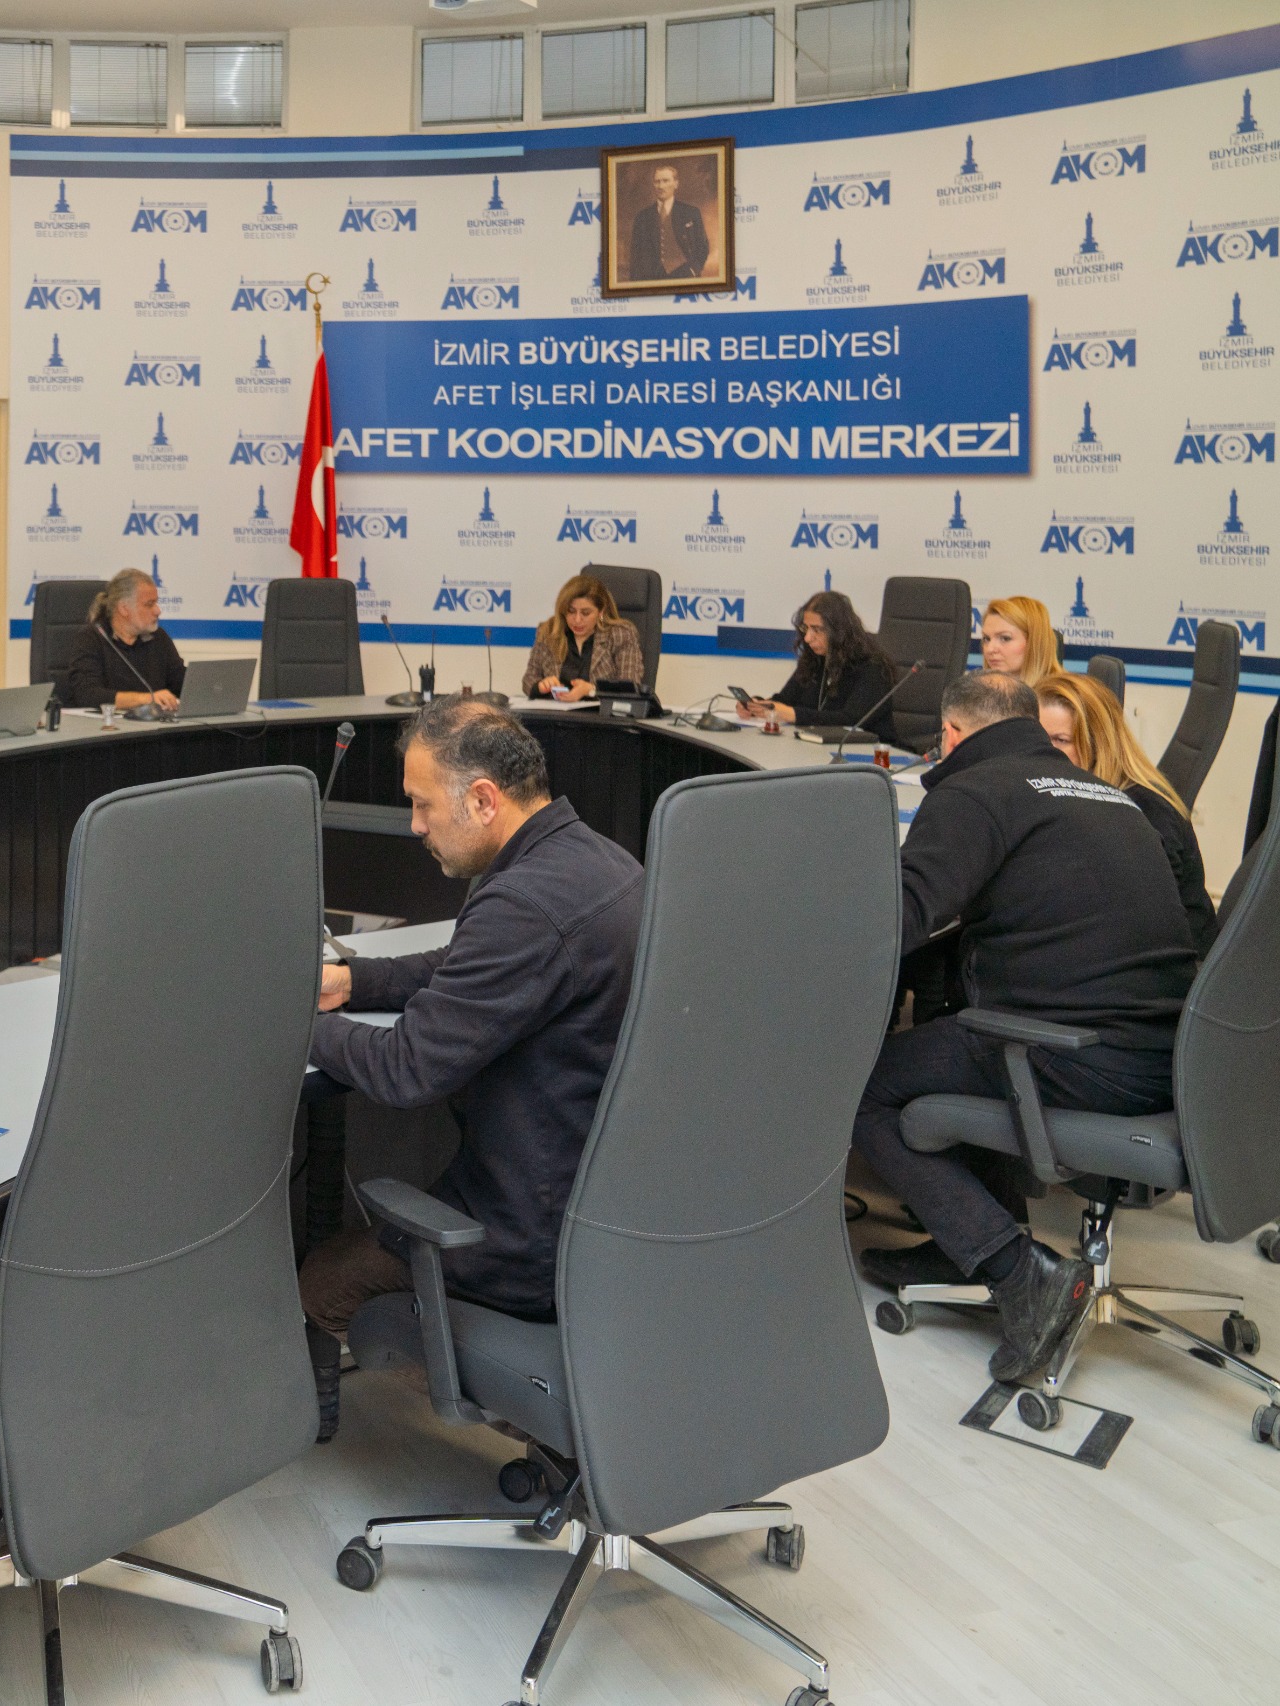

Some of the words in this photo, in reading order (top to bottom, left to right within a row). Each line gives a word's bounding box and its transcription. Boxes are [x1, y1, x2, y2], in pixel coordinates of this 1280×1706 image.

[1051, 144, 1146, 185] AKOM
[804, 180, 890, 212] AKOM
[131, 210, 208, 232] AKOM
[339, 208, 416, 232] AKOM
[568, 201, 601, 226] AK
[1176, 227, 1280, 268] AKOM
[917, 256, 1006, 290] AKOM
[24, 287, 101, 310] AKOM
[231, 288, 307, 311] AKOM
[441, 286, 519, 310] AKOM
[434, 339, 510, 366] İZMİR
[519, 333, 711, 368] BÜYÜKŞEHİR
[720, 326, 900, 361] BELEDİYESİ
[1043, 338, 1136, 372] AKOM
[125, 364, 200, 386] AKOM
[433, 385, 502, 405] AFET
[511, 380, 596, 410] İŞLERİ
[607, 378, 716, 404] DAİRESİ
[728, 373, 901, 407] BAŞKANLIĞI
[333, 428, 438, 458] AFET
[448, 420, 799, 459] KOORDİNASYON
[812, 413, 1019, 459] MERKEZİ
[1174, 432, 1275, 464] AKOM
[24, 442, 100, 465] AKOM
[230, 443, 302, 466] AKOM
[122, 513, 198, 536] AKOM
[337, 515, 407, 538] AKOM
[556, 518, 636, 544] AKOM
[790, 522, 878, 549] AKOM
[1040, 526, 1134, 554] AKOM
[224, 584, 260, 608] AK
[433, 588, 511, 613] AKOM
[662, 595, 744, 622] AKOM
